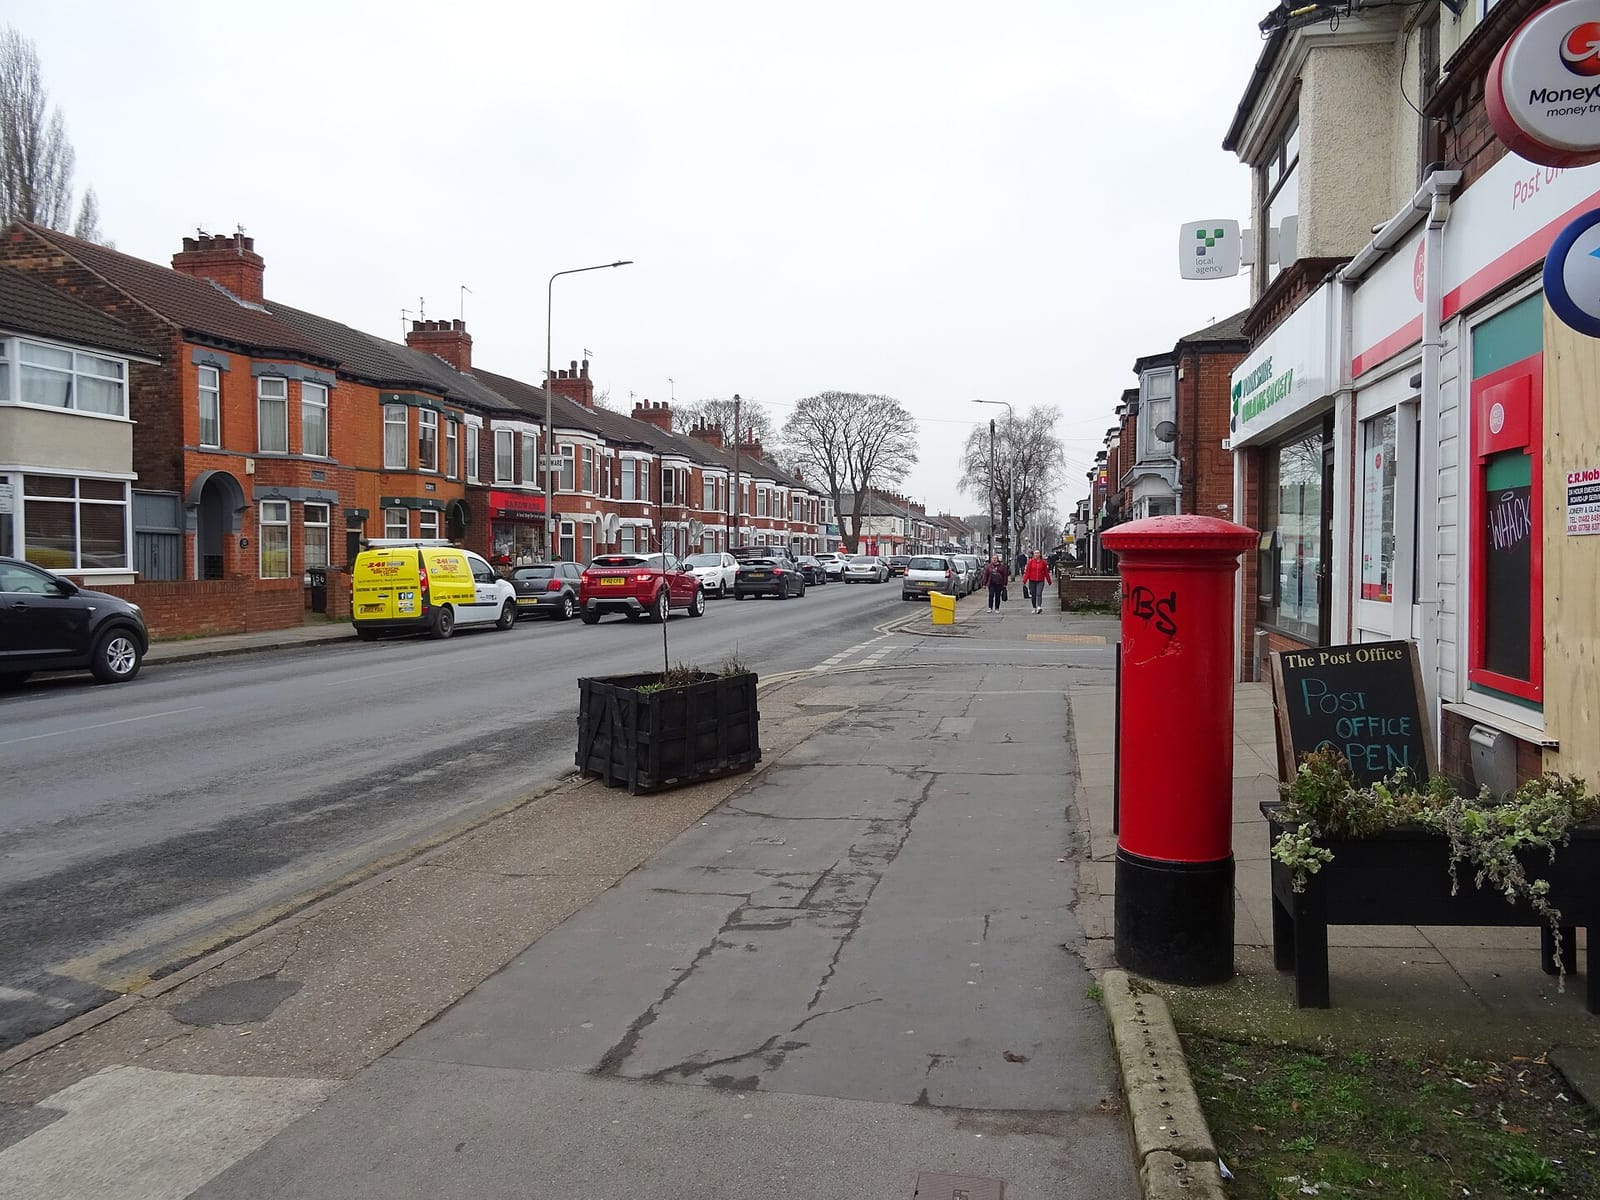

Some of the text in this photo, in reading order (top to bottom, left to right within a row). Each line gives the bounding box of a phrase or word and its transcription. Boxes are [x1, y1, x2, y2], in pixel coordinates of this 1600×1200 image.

[1547, 106, 1587, 117] money
[1513, 168, 1541, 210] Post
[1196, 257, 1214, 265] local
[1196, 266, 1223, 274] agency
[1266, 368, 1293, 408] SOCIETY
[1487, 496, 1532, 550] WHACK
[1285, 648, 1403, 668] The Post Office
[1336, 716, 1412, 739] OFFICE
